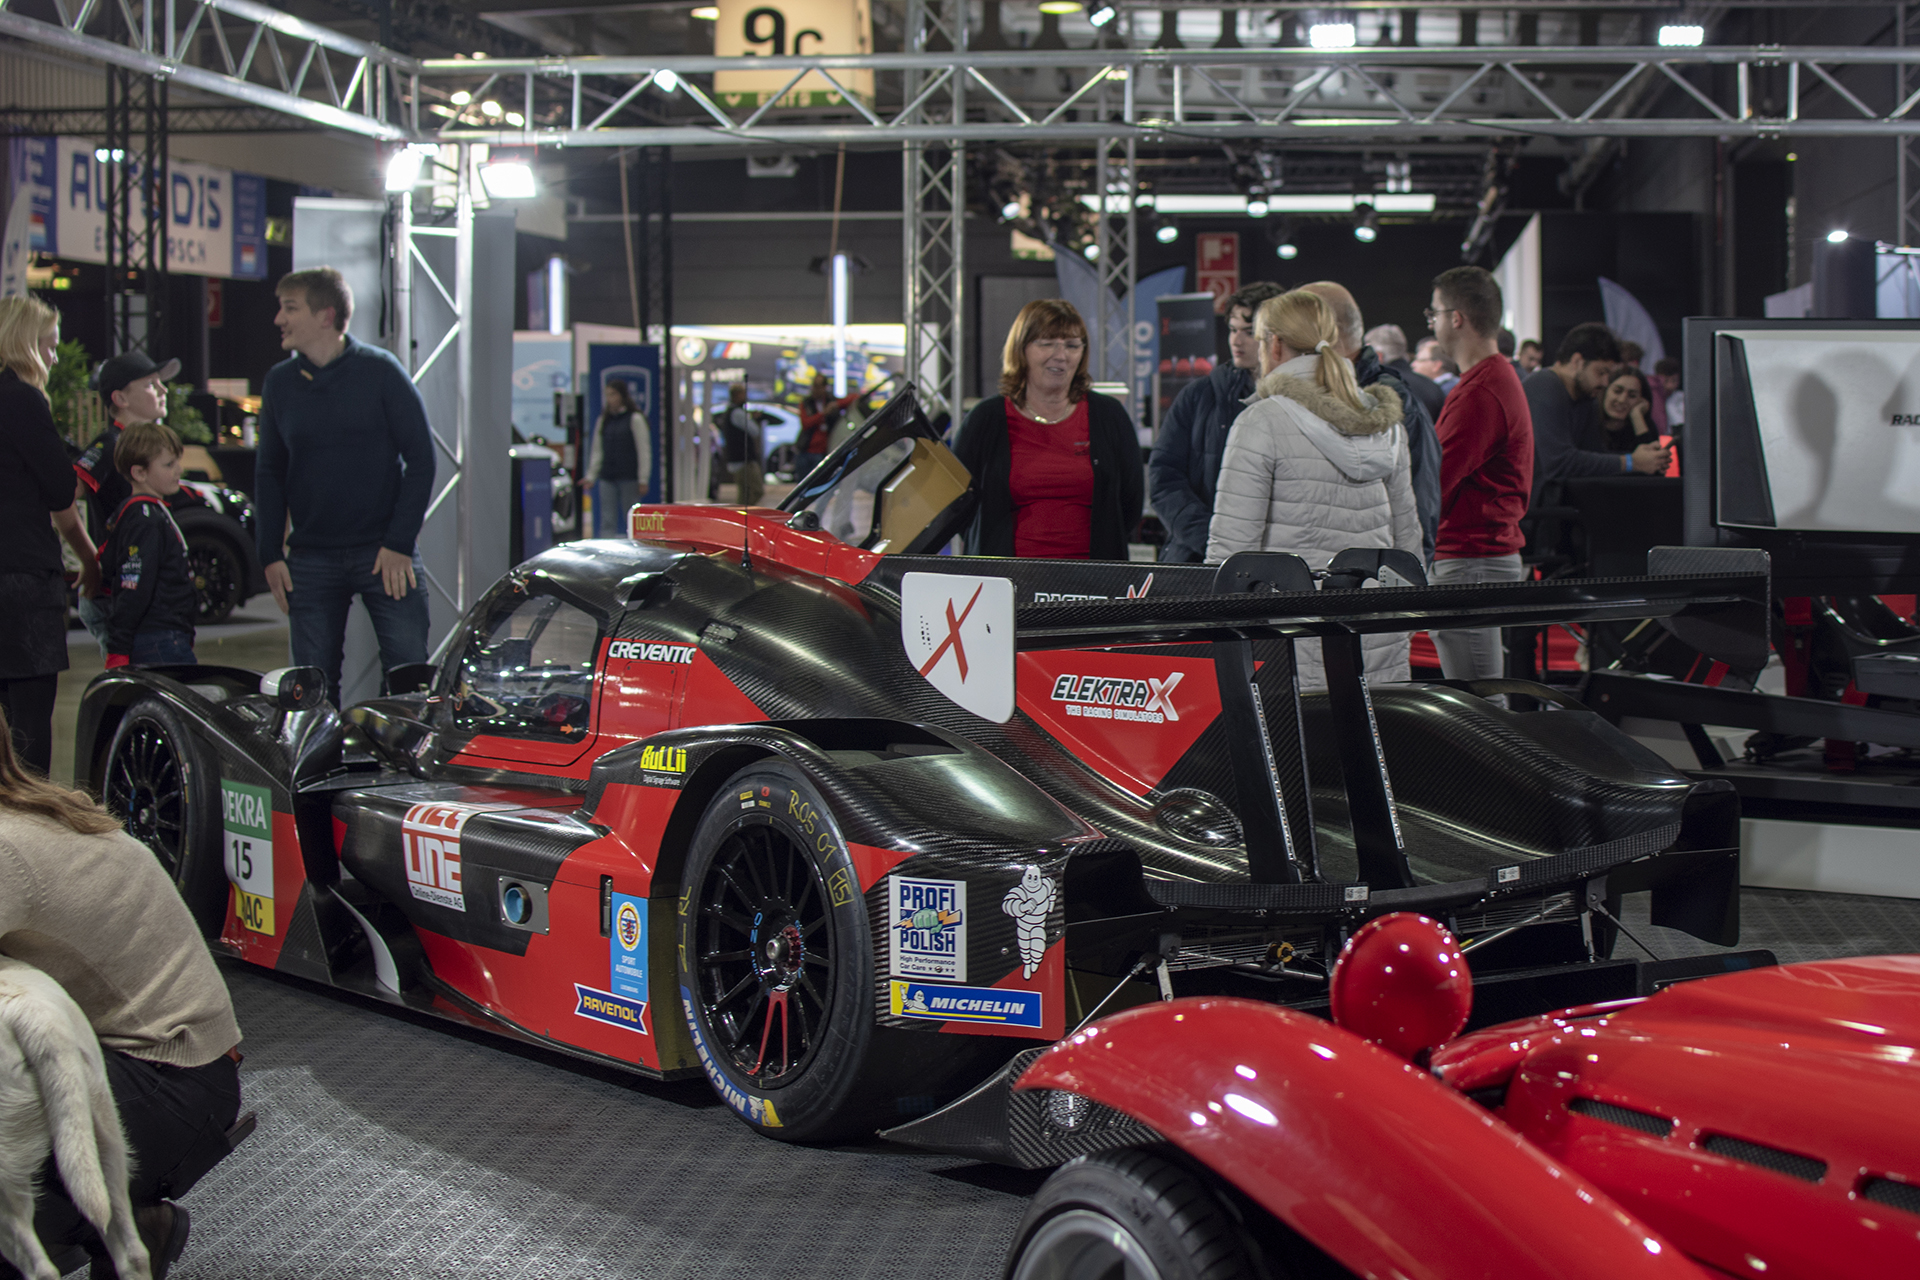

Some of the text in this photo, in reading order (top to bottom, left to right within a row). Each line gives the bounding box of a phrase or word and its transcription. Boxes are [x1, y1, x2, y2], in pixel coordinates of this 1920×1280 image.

[1065, 704, 1164, 724] THE RACING SIMULATORS
[232, 838, 253, 881] 15
[900, 884, 955, 912] PROFI
[900, 930, 955, 953] POLISH
[914, 956, 956, 966] Performance
[583, 995, 638, 1023] RAVENOL
[930, 996, 1026, 1015] MICHELIN
[683, 998, 747, 1113] MICHELIN
